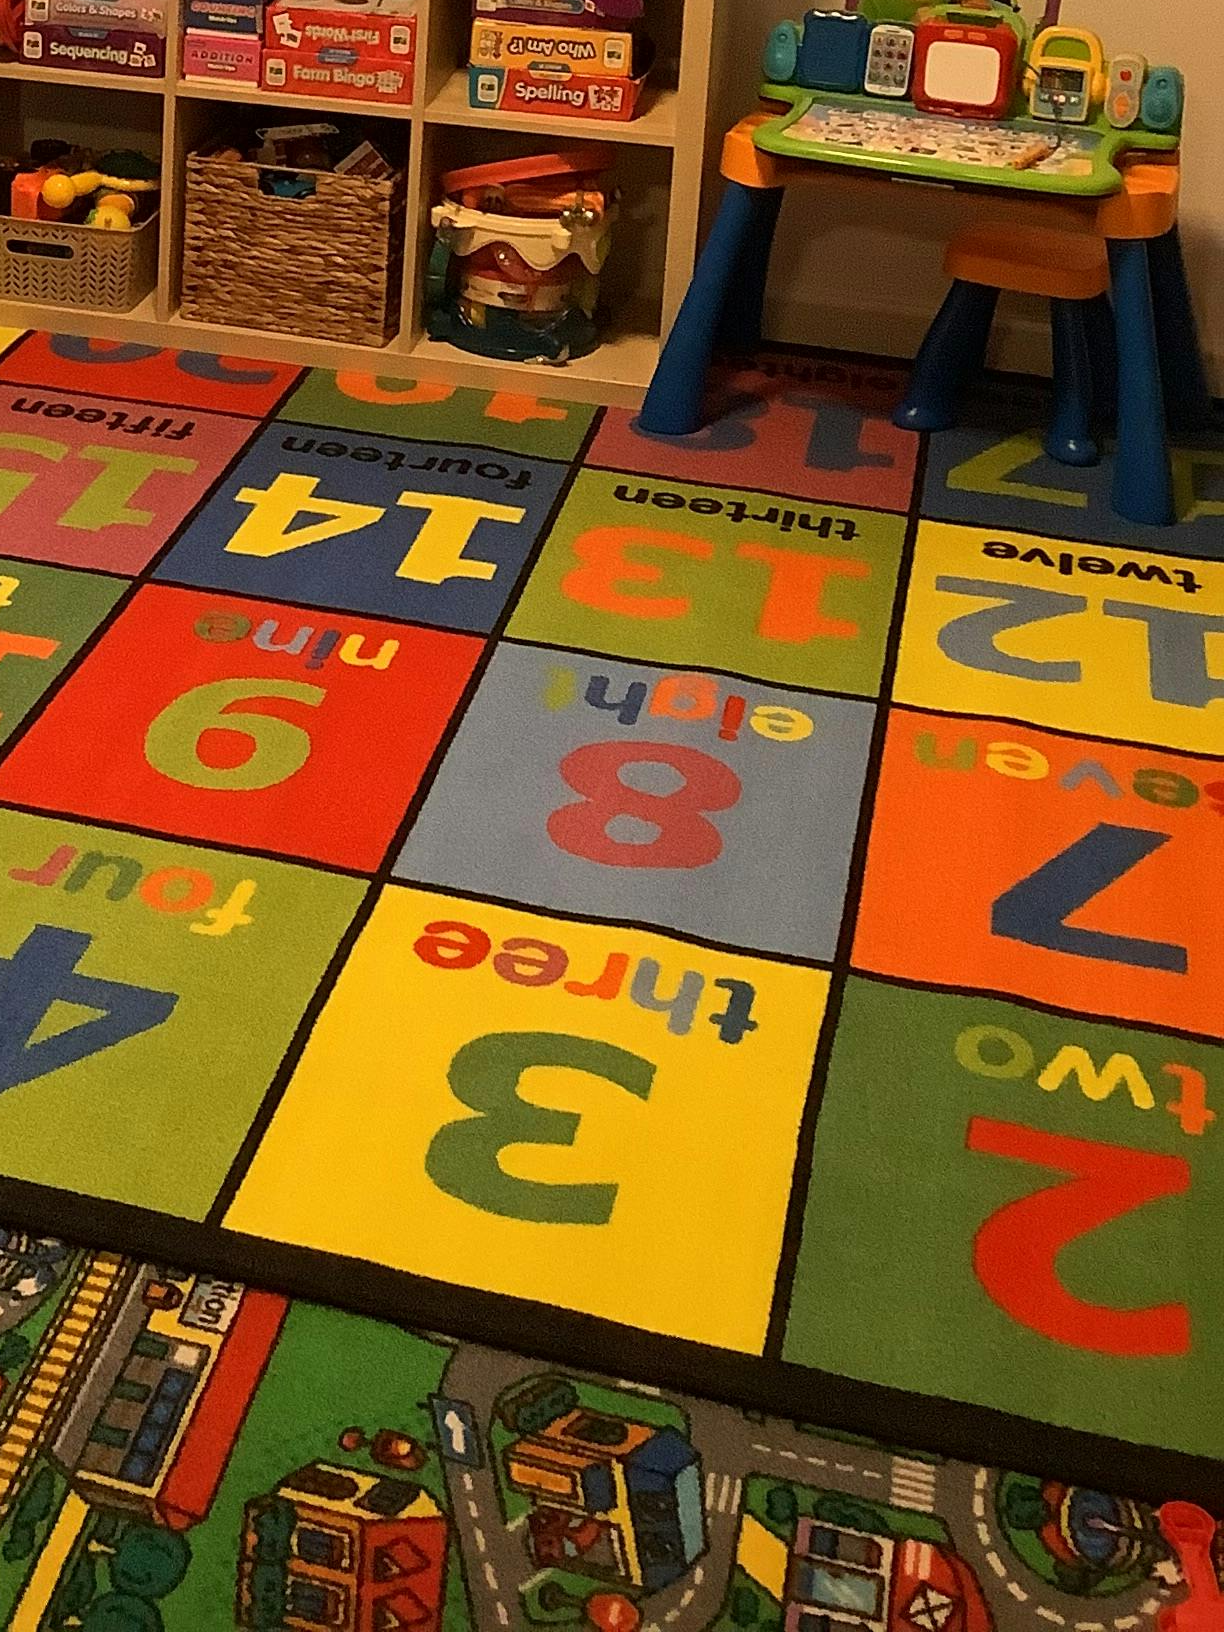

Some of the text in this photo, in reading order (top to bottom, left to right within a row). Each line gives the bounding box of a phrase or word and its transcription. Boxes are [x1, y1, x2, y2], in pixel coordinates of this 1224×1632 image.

[55, 1, 137, 19] Colors & Shapes
[304, 24, 380, 45] First Words
[49, 41, 128, 65] Sequencing
[191, 49, 253, 64] ADDITION
[293, 65, 376, 87] Farm Bingo
[509, 38, 595, 58] Who Am I?
[514, 81, 585, 105] Spelling
[10, 395, 198, 441] fifteen
[280, 435, 538, 492] fourteen
[222, 471, 526, 586] 14
[613, 484, 861, 541] thirteen
[559, 524, 871, 645] 13
[982, 539, 1203, 595] twelve
[193, 610, 400, 670] nine
[935, 575, 1224, 710] 12
[143, 676, 327, 792] 9
[542, 666, 816, 743] eight
[546, 739, 743, 869] 8
[10, 844, 258, 938] four
[991, 821, 1189, 976] 7
[412, 919, 760, 1045] three
[954, 1023, 1217, 1137] two
[423, 1030, 659, 1227] 3
[964, 1115, 1191, 1358] 2
